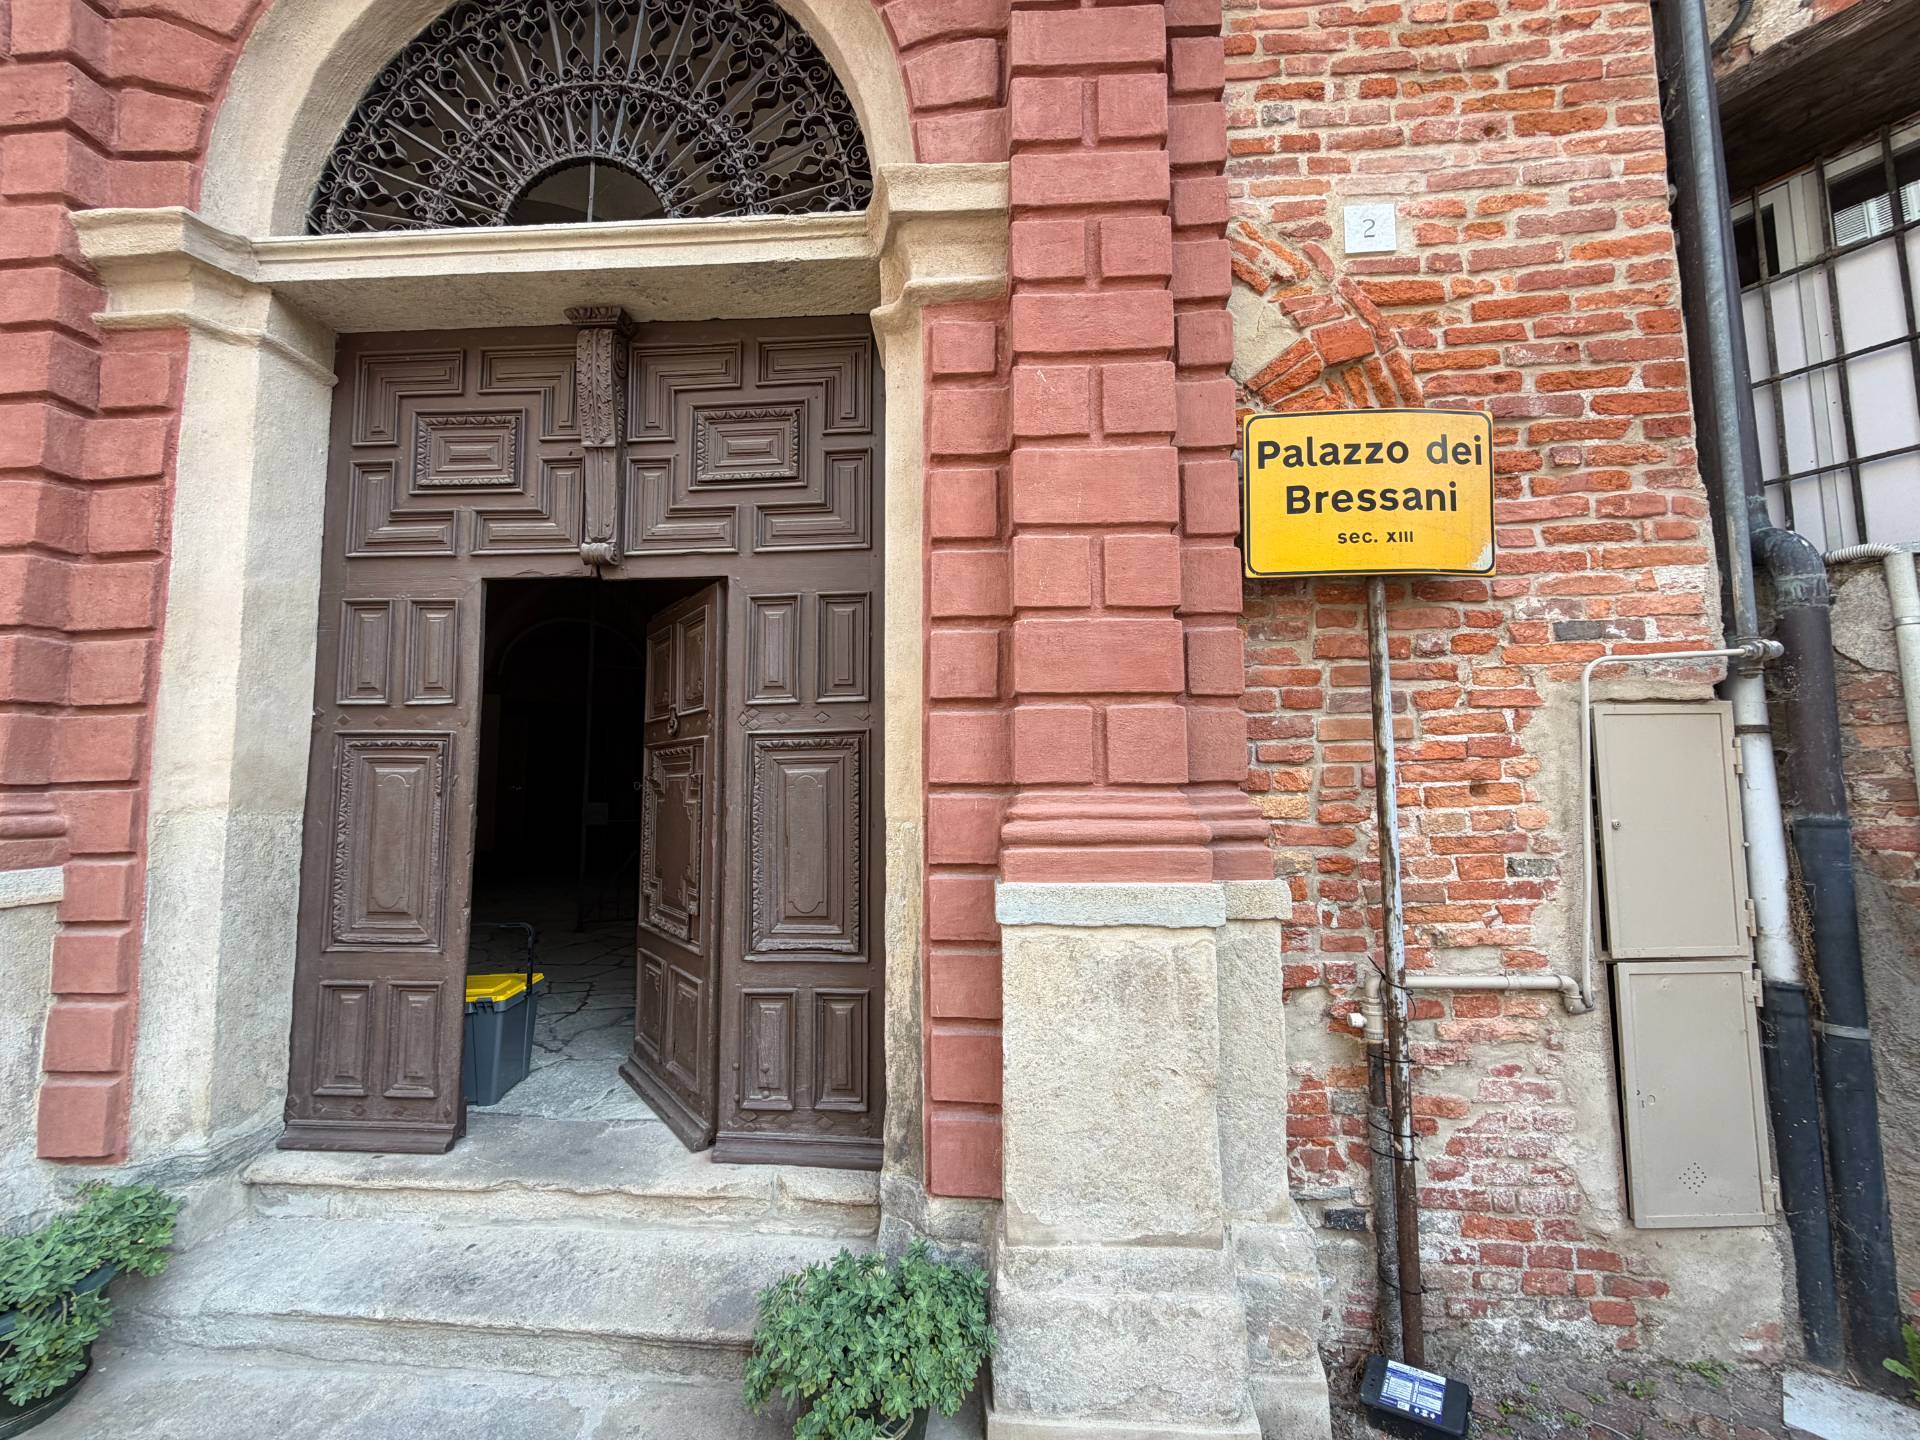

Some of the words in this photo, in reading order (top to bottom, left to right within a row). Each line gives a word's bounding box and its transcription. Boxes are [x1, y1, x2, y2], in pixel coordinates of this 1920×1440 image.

[1362, 218, 1376, 238] 2
[1257, 436, 1409, 470] Palazzo
[1426, 434, 1482, 466] dei
[1286, 480, 1458, 515] Bressani
[1337, 532, 1379, 545] sec.
[1386, 531, 1415, 543] XIII
